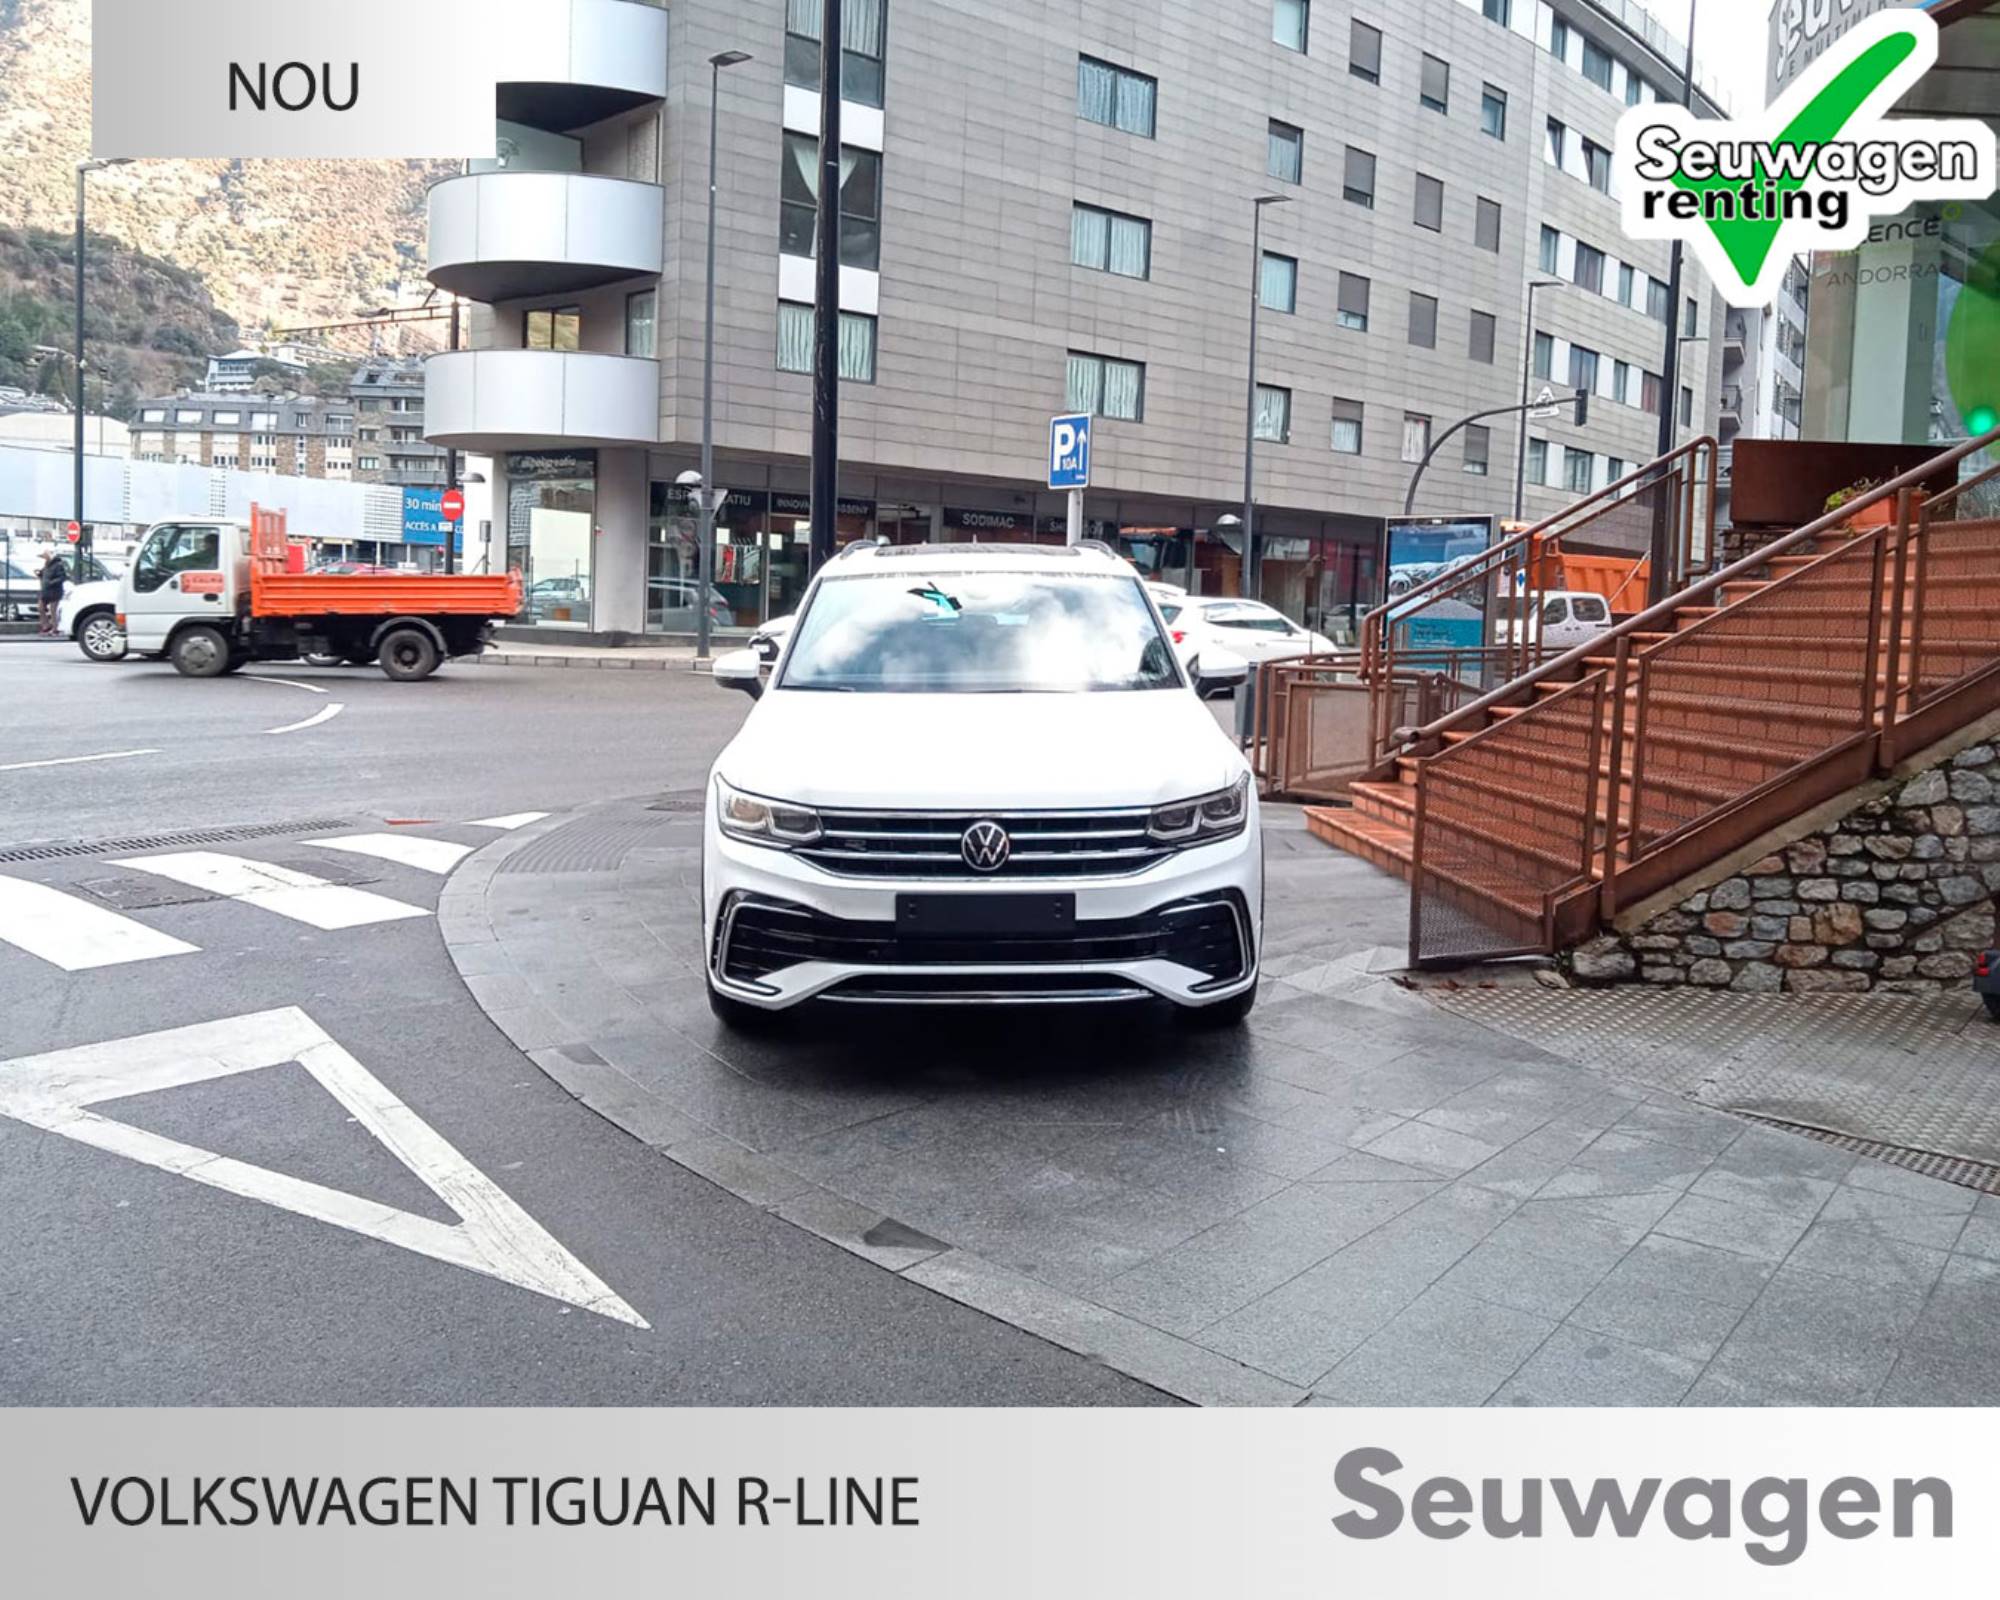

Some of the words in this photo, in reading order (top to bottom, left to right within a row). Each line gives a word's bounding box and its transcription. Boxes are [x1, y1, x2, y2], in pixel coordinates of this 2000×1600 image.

[1862, 219, 1941, 244] ENCE
[1826, 263, 1940, 288] ANDORRA
[1053, 424, 1075, 471] P
[405, 497, 420, 510] 30
[962, 513, 1016, 529] SODIMAC
